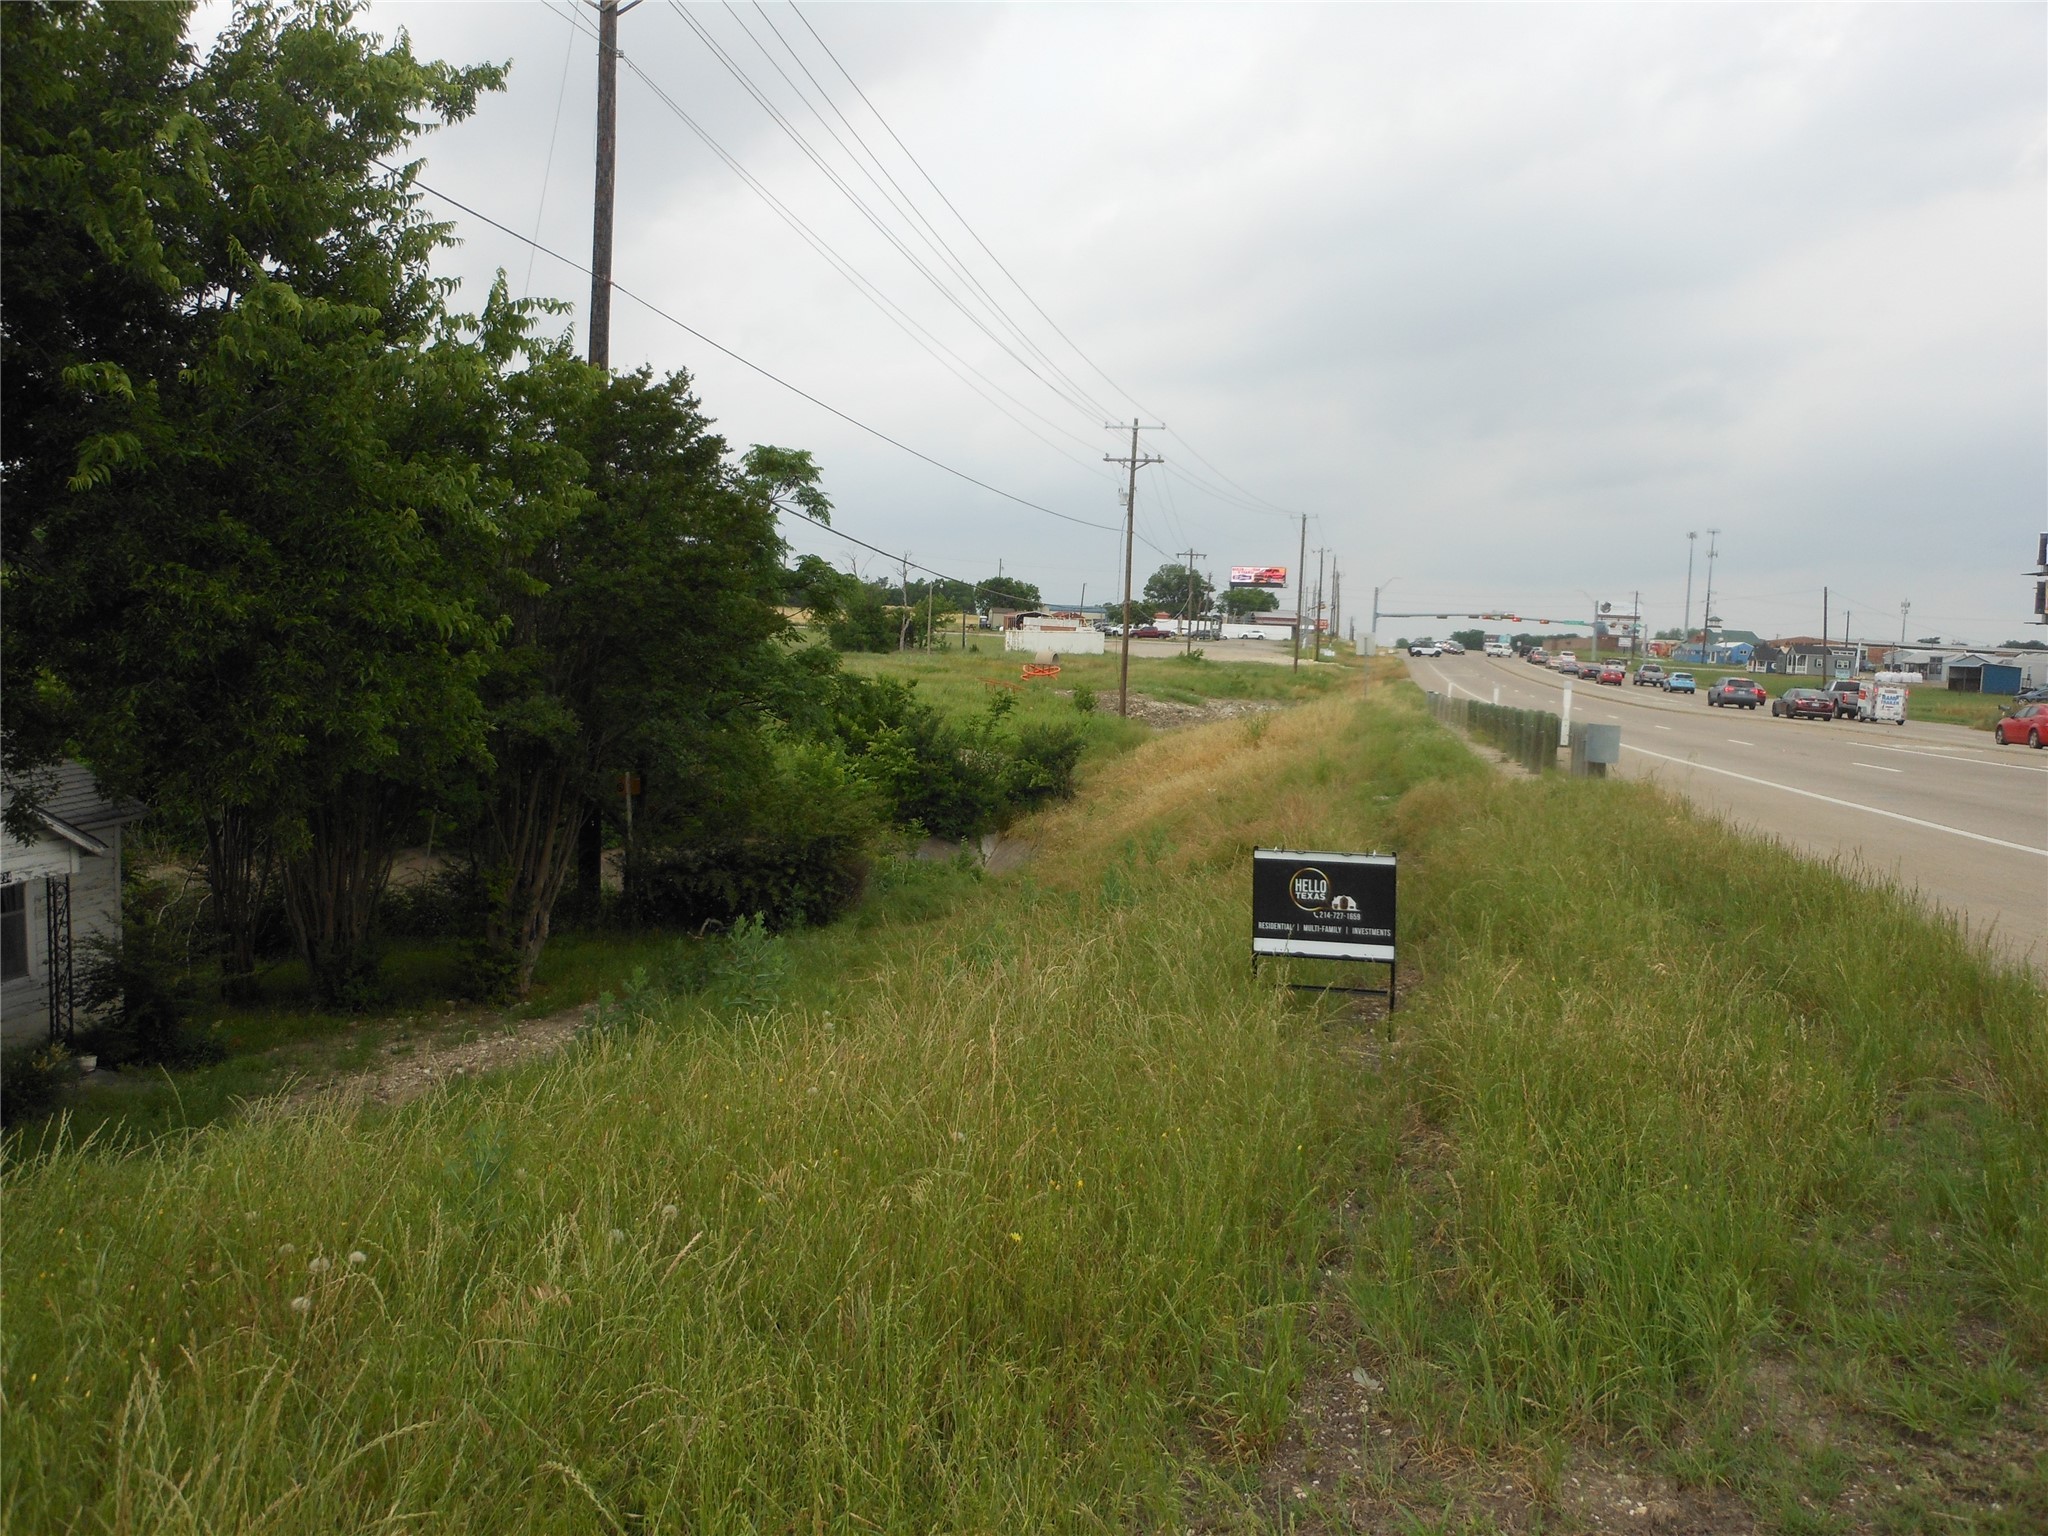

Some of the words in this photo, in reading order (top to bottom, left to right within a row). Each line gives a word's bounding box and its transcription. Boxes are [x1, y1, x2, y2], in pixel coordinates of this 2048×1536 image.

[1295, 878, 1327, 893] HELLO
[1295, 892, 1326, 900] TEXAS
[1258, 922, 1293, 931] RESIDENTIAL
[1303, 924, 1342, 934] MULTI-FAMILY
[1352, 927, 1391, 937] INVESTMENTS
